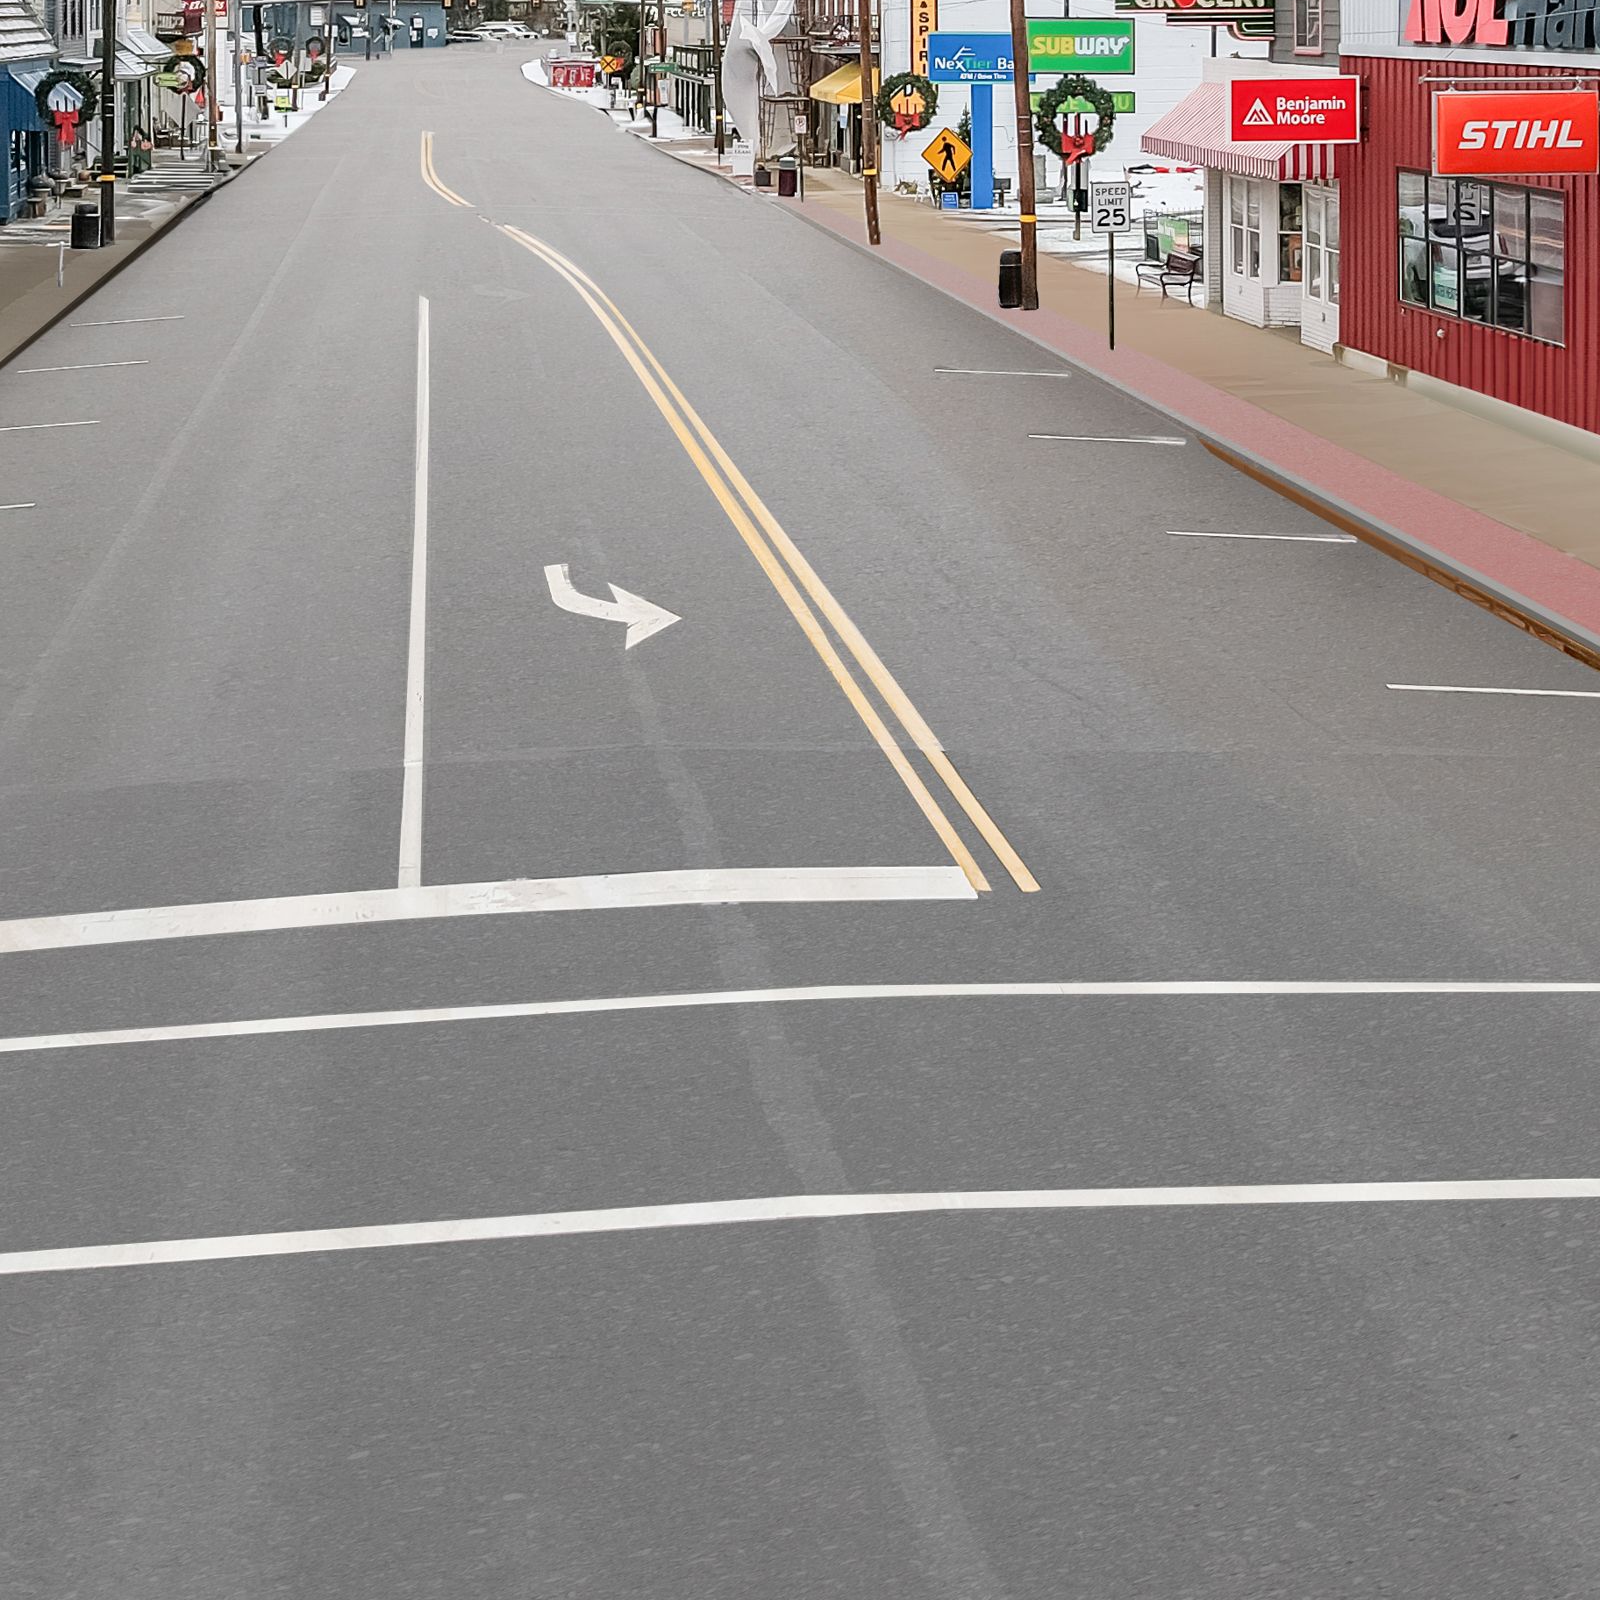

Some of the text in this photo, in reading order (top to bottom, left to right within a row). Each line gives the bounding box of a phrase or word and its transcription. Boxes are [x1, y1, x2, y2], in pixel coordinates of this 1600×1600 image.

[1030, 34, 1131, 56] SUBWAY
[997, 57, 1015, 70] Ba
[1276, 97, 1347, 112] Benjamin
[1276, 111, 1326, 125] Moore
[1458, 119, 1584, 150] STIHL
[1095, 187, 1127, 197] SPEED
[1098, 198, 1123, 207] LIMIT
[1097, 208, 1126, 227] 25
